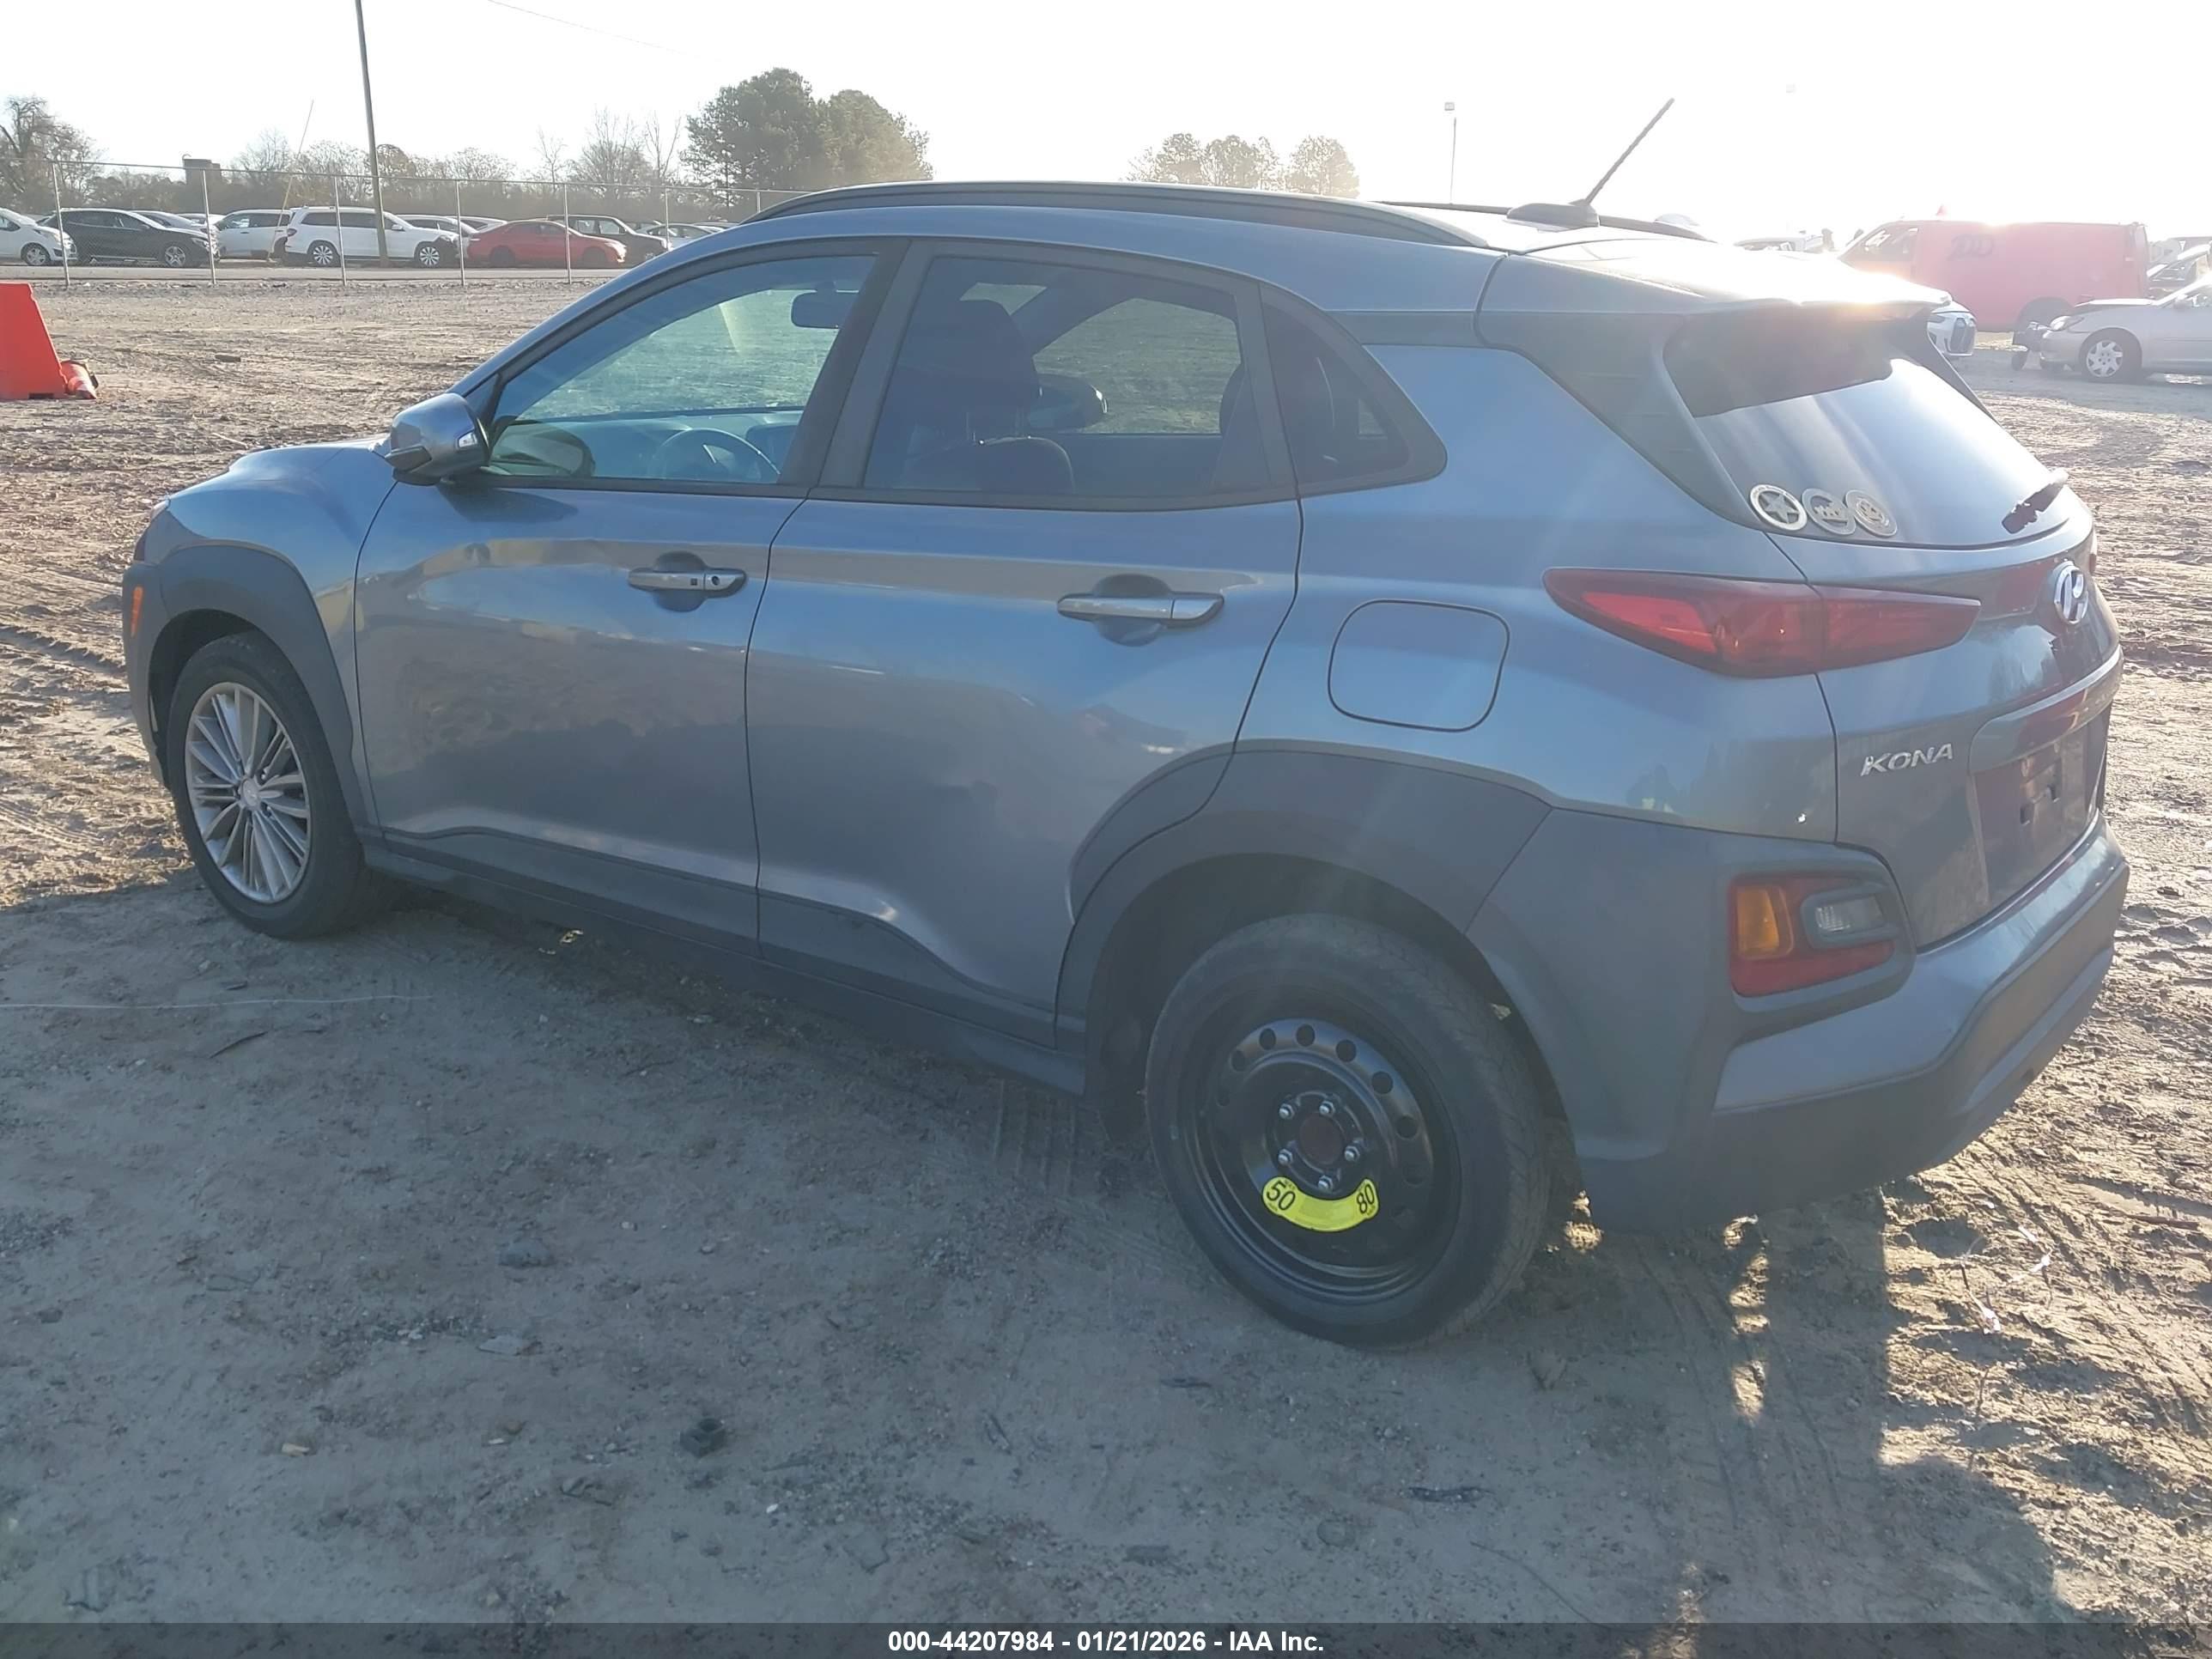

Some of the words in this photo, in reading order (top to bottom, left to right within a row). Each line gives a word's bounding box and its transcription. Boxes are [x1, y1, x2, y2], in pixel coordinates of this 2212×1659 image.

[1860, 743, 1954, 776] KONA
[1266, 1180, 1296, 1211] 50
[1356, 1183, 1375, 1214] 80
